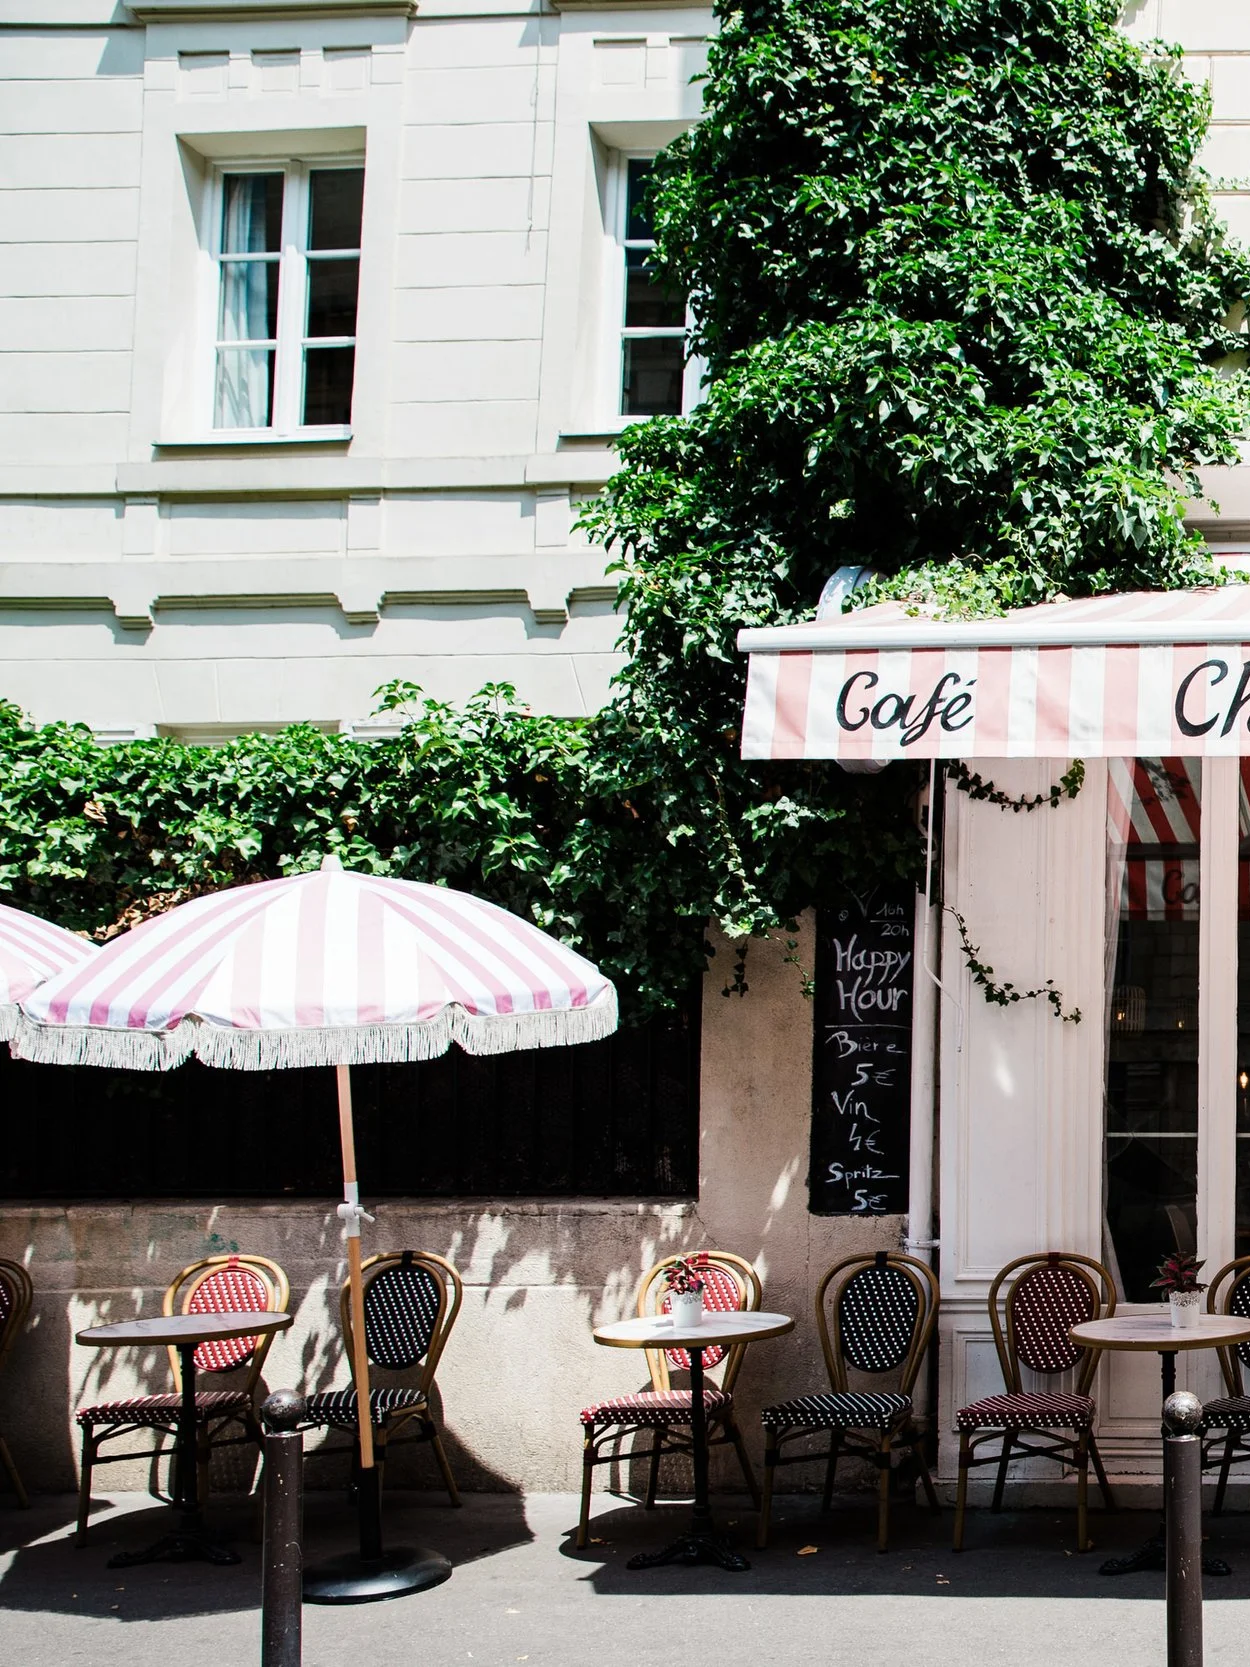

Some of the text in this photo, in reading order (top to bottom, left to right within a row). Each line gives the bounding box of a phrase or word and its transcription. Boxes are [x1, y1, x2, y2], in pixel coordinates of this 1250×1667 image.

[836, 670, 978, 747] Café
[875, 902, 905, 917] 16h
[880, 922, 910, 937] 20h
[833, 933, 911, 987] Happy
[836, 976, 908, 1022] Hour
[830, 1089, 881, 1123] Vin
[825, 1162, 901, 1190] Spritz
